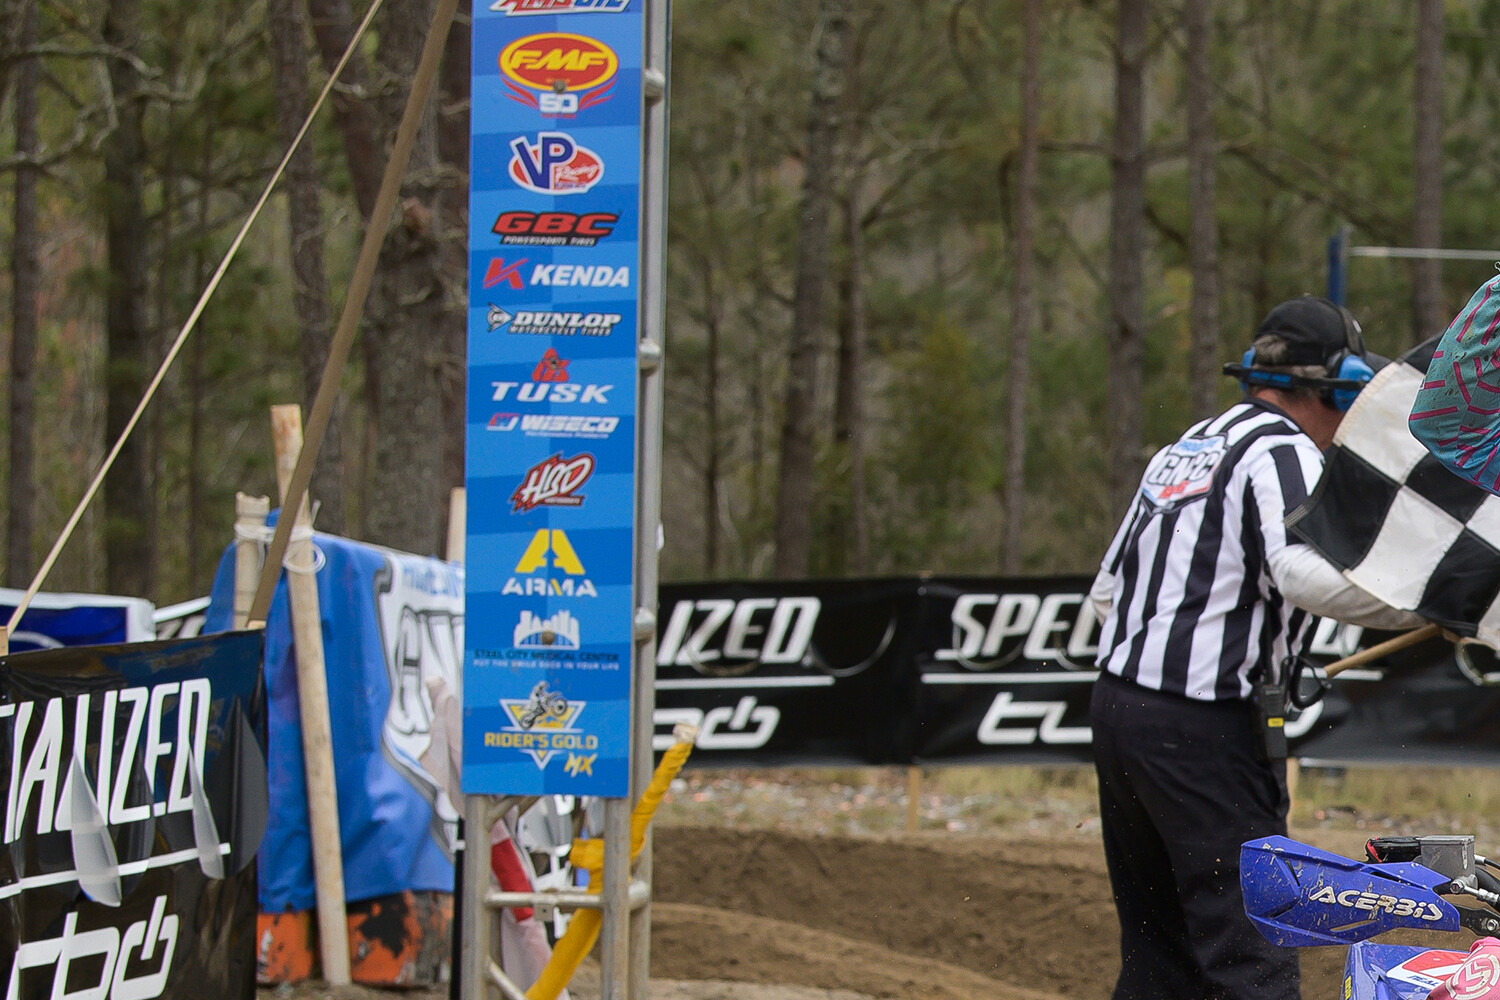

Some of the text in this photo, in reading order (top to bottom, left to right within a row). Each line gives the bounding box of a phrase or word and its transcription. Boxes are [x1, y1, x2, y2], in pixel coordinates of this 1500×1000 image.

[510, 49, 608, 71] FMF
[515, 136, 574, 189] VP
[493, 212, 618, 236] GBC
[530, 264, 629, 287] KENDA
[513, 311, 621, 328] DUNLOP
[491, 382, 614, 404] TUSK
[521, 415, 619, 433] WISECO
[484, 732, 599, 749] RIDER'S GOLD
[563, 753, 597, 777] MX
[1309, 886, 1444, 922] ACERBIS
